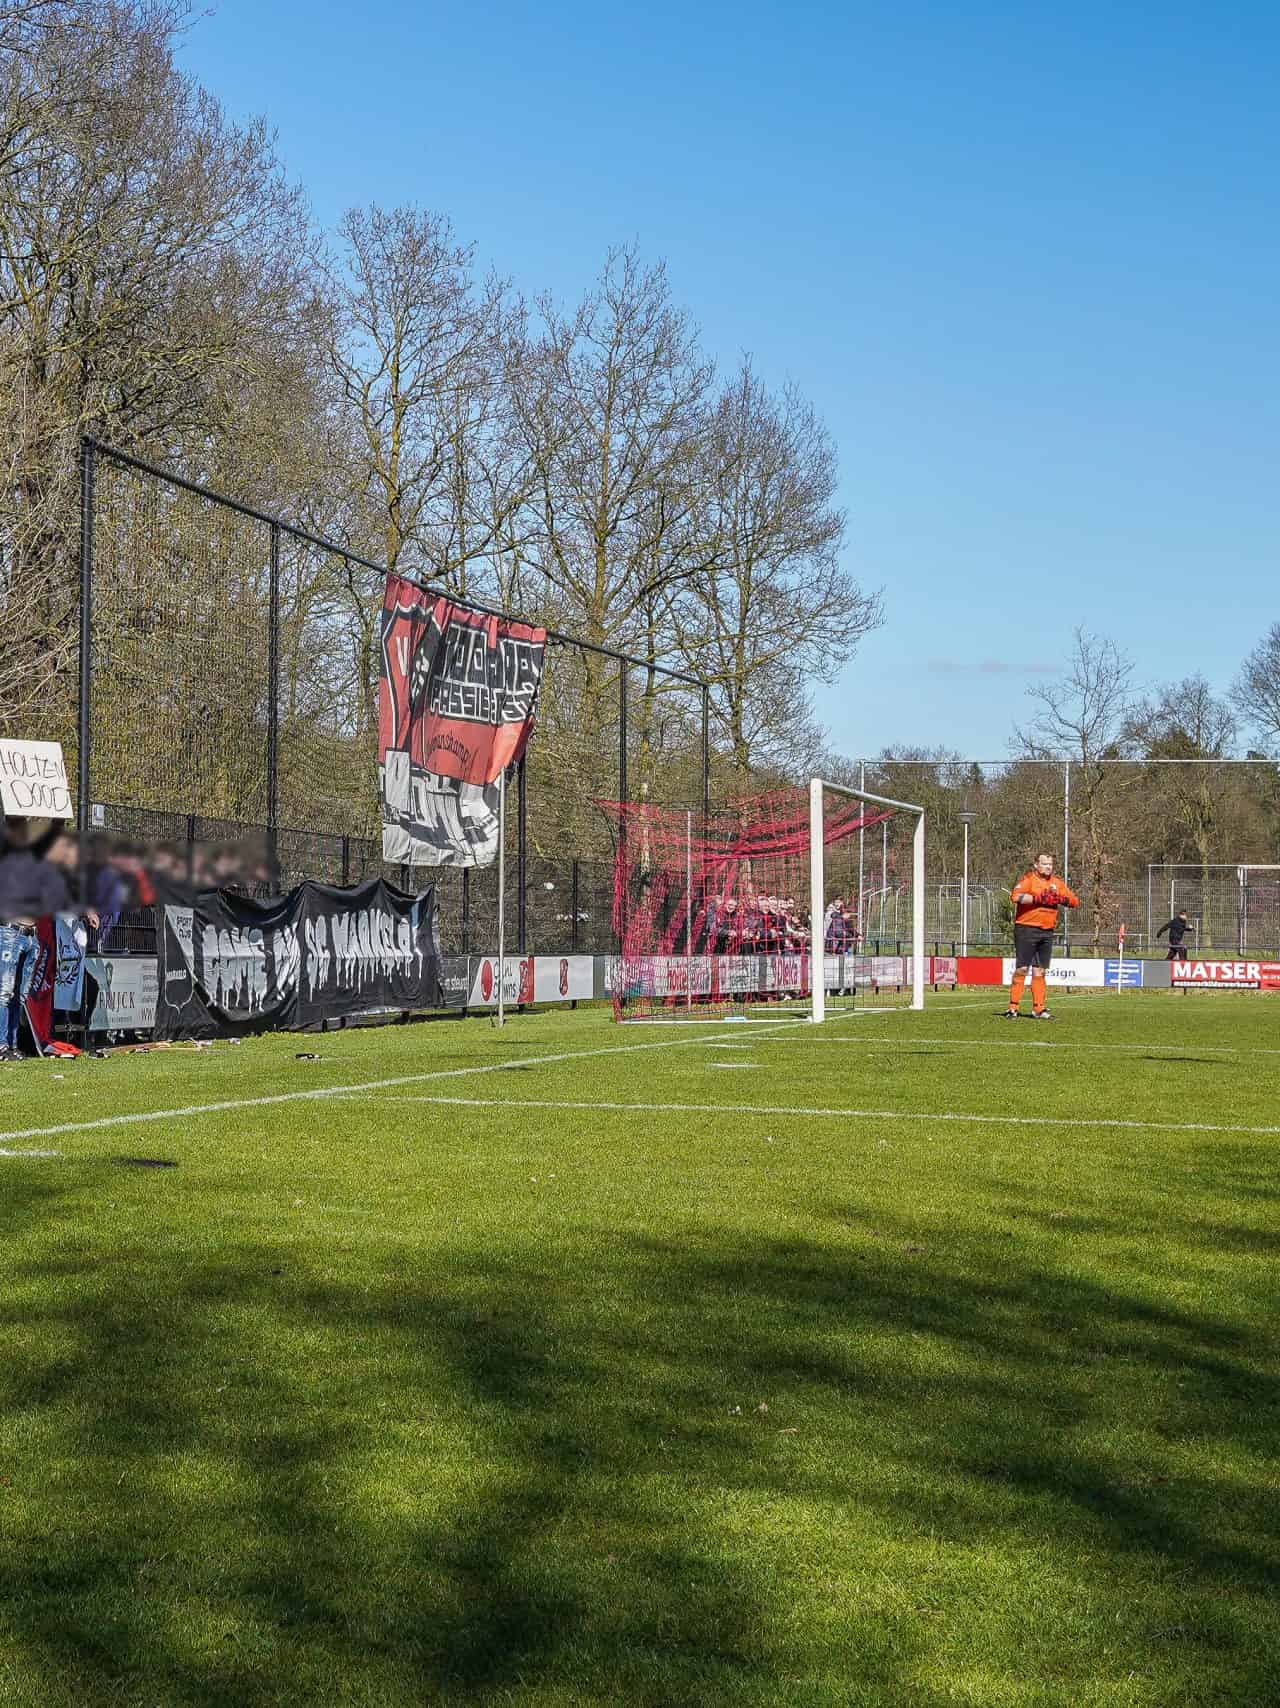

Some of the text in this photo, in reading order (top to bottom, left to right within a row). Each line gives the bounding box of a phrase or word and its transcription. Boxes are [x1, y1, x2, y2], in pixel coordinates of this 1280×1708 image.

[0, 749, 65, 779] HOLTEN
[1044, 967, 1077, 979] esign
[1173, 961, 1261, 979] MATSER
